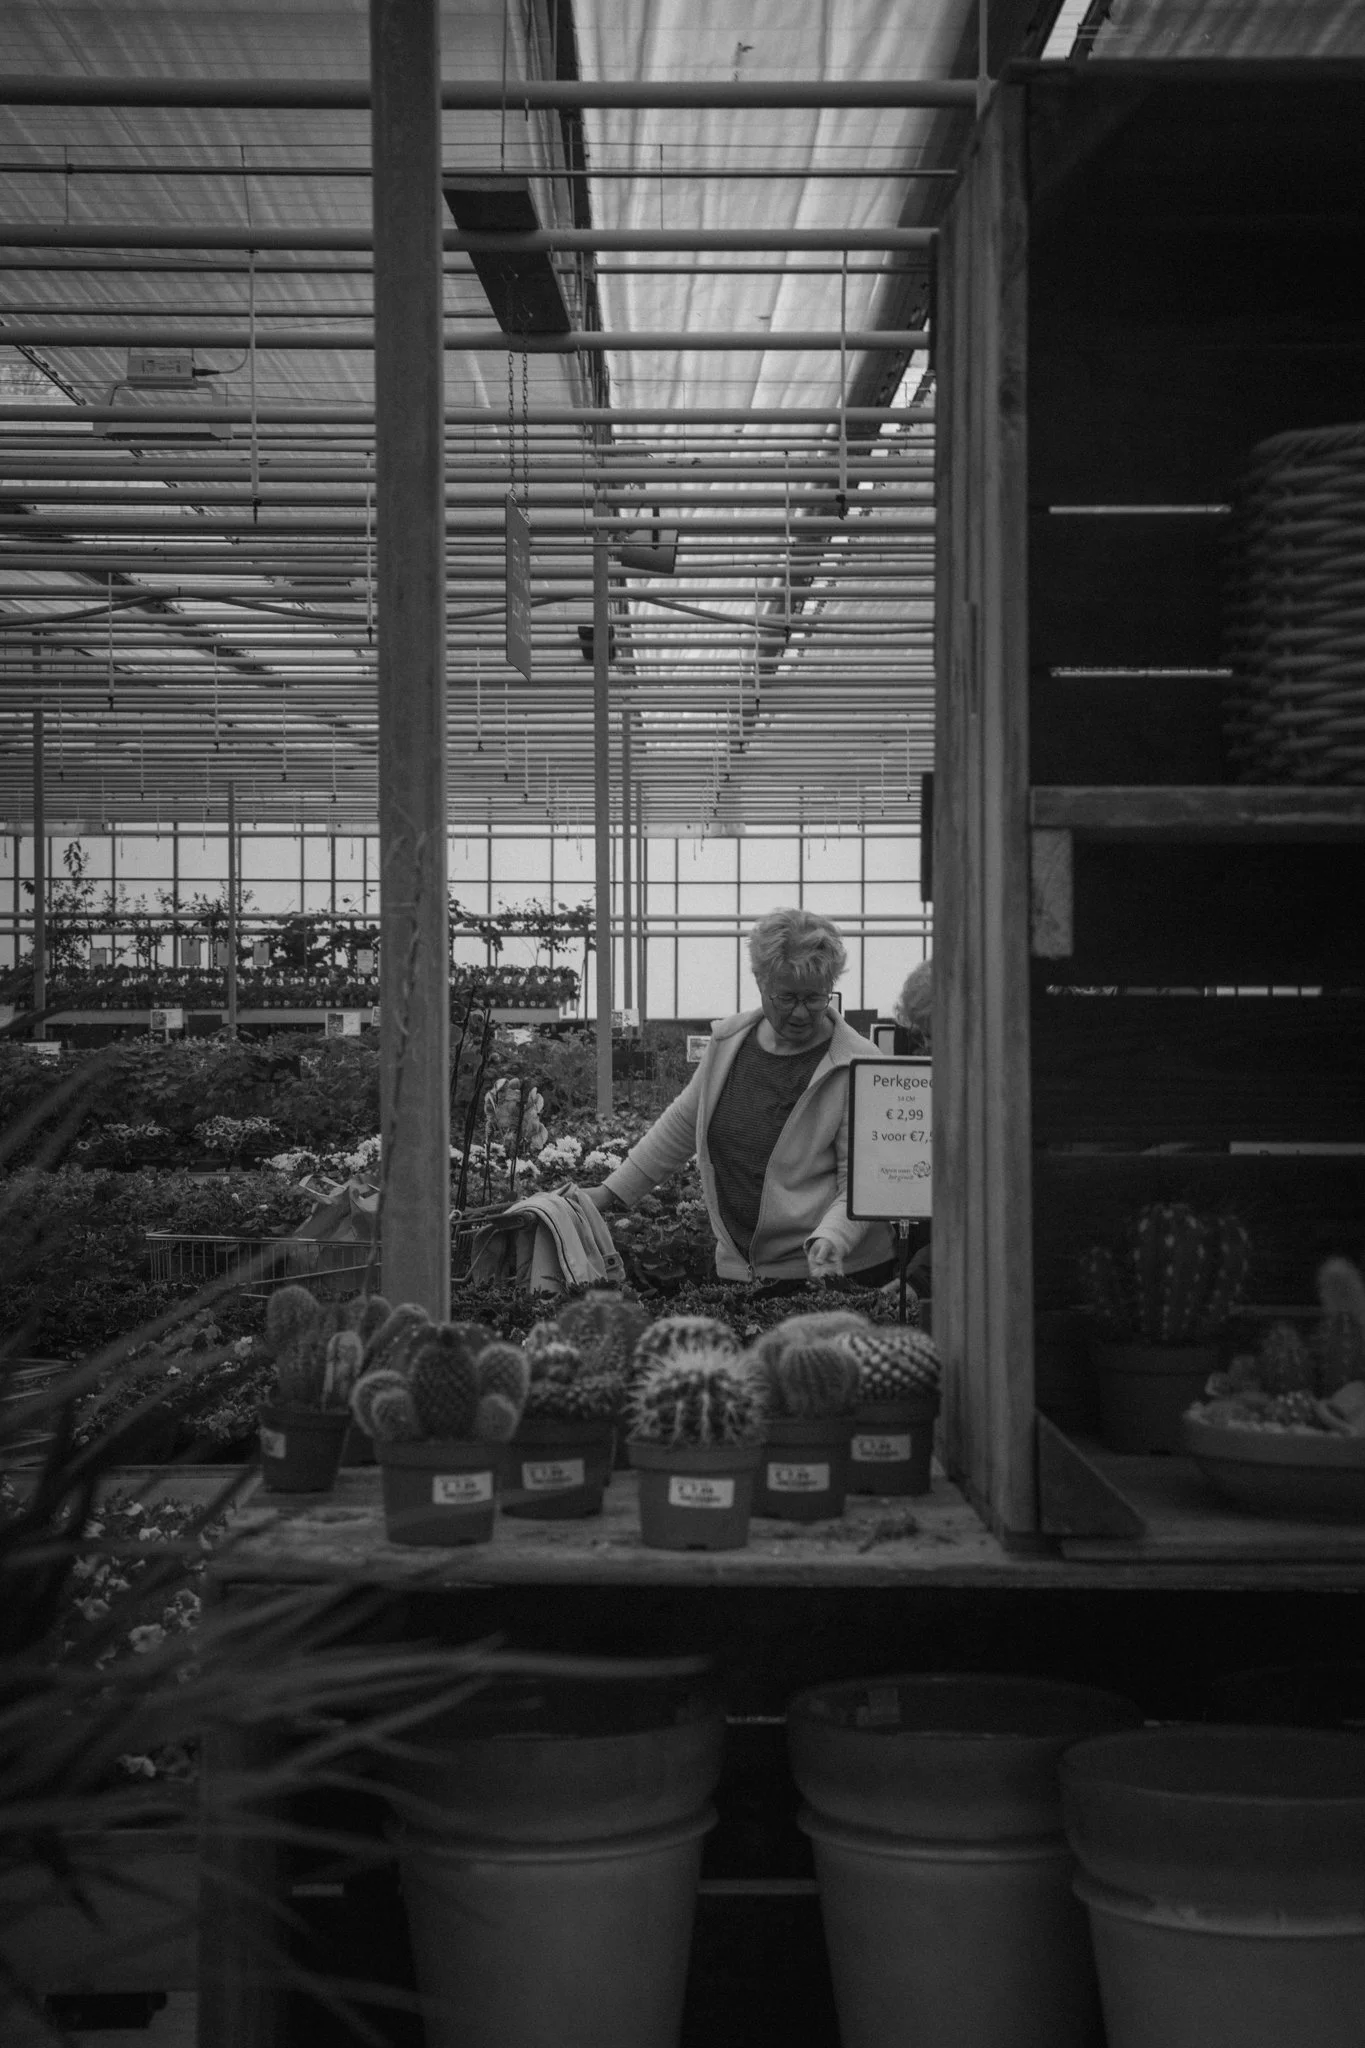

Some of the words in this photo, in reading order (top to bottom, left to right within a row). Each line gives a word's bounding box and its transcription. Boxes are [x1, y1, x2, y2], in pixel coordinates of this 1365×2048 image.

[886, 1108, 893, 1120] €
[897, 1108, 924, 1122] 2,99
[872, 1130, 878, 1141] 3
[881, 1133, 906, 1141] voor
